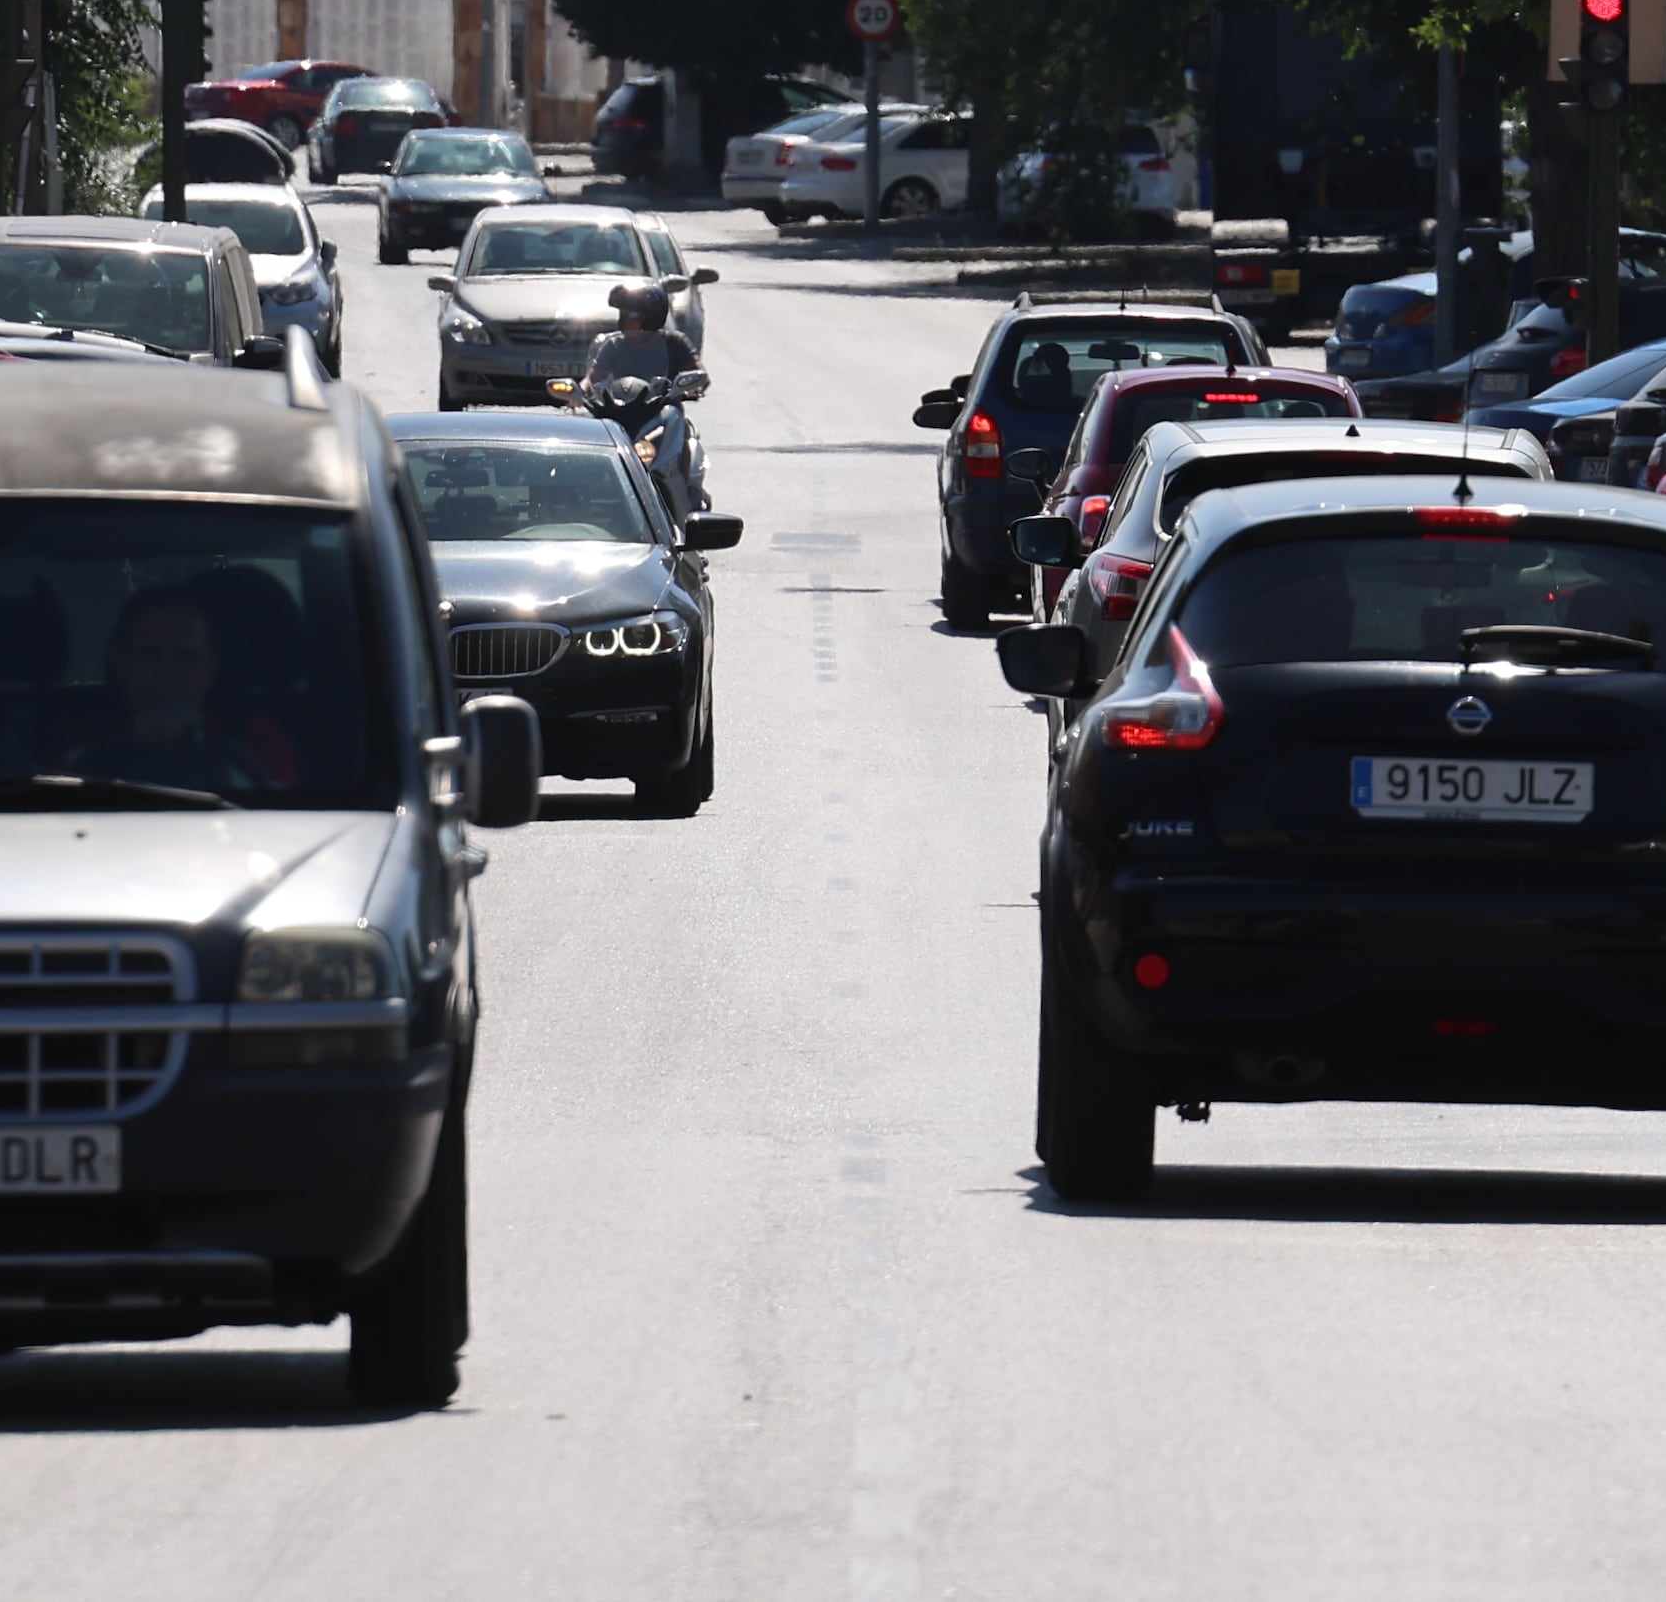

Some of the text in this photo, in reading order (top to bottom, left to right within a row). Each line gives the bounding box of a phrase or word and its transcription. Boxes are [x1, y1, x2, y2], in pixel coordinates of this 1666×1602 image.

[859, 5, 888, 23] 20
[1387, 763, 1484, 803] 9150
[1503, 767, 1576, 806] JLZ
[1118, 820, 1194, 840] JUKE
[0, 1135, 99, 1184] DLR
